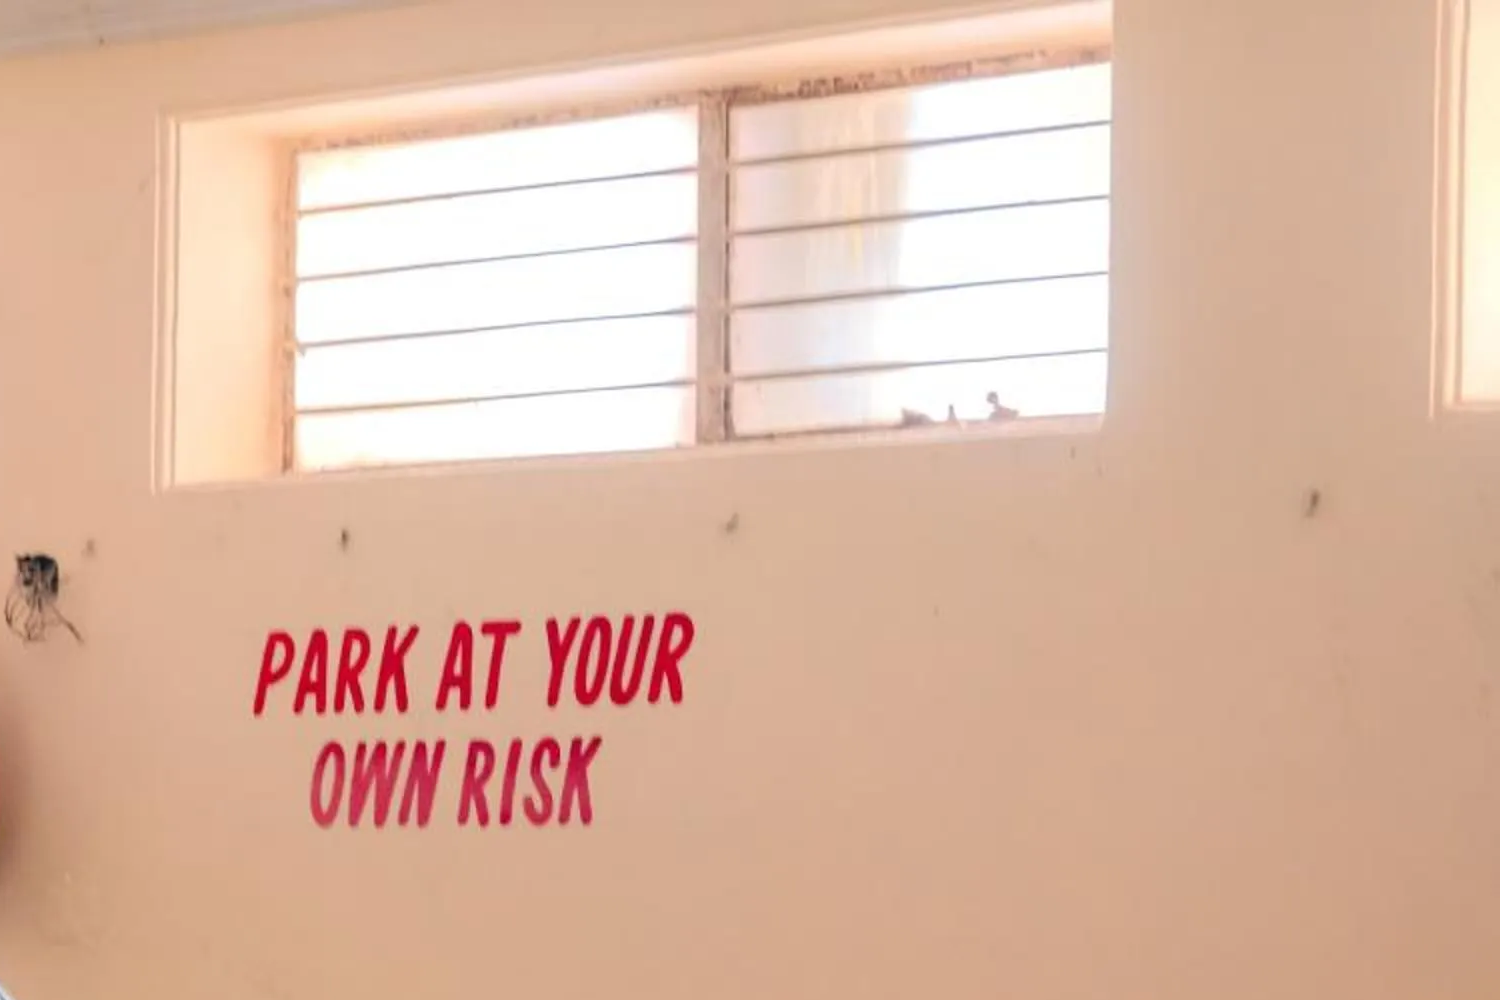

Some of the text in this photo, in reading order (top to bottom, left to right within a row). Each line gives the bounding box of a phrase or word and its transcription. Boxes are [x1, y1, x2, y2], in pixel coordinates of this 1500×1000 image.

[252, 611, 696, 717] PARK AT YOUR
[309, 735, 603, 830] OWN RISK
